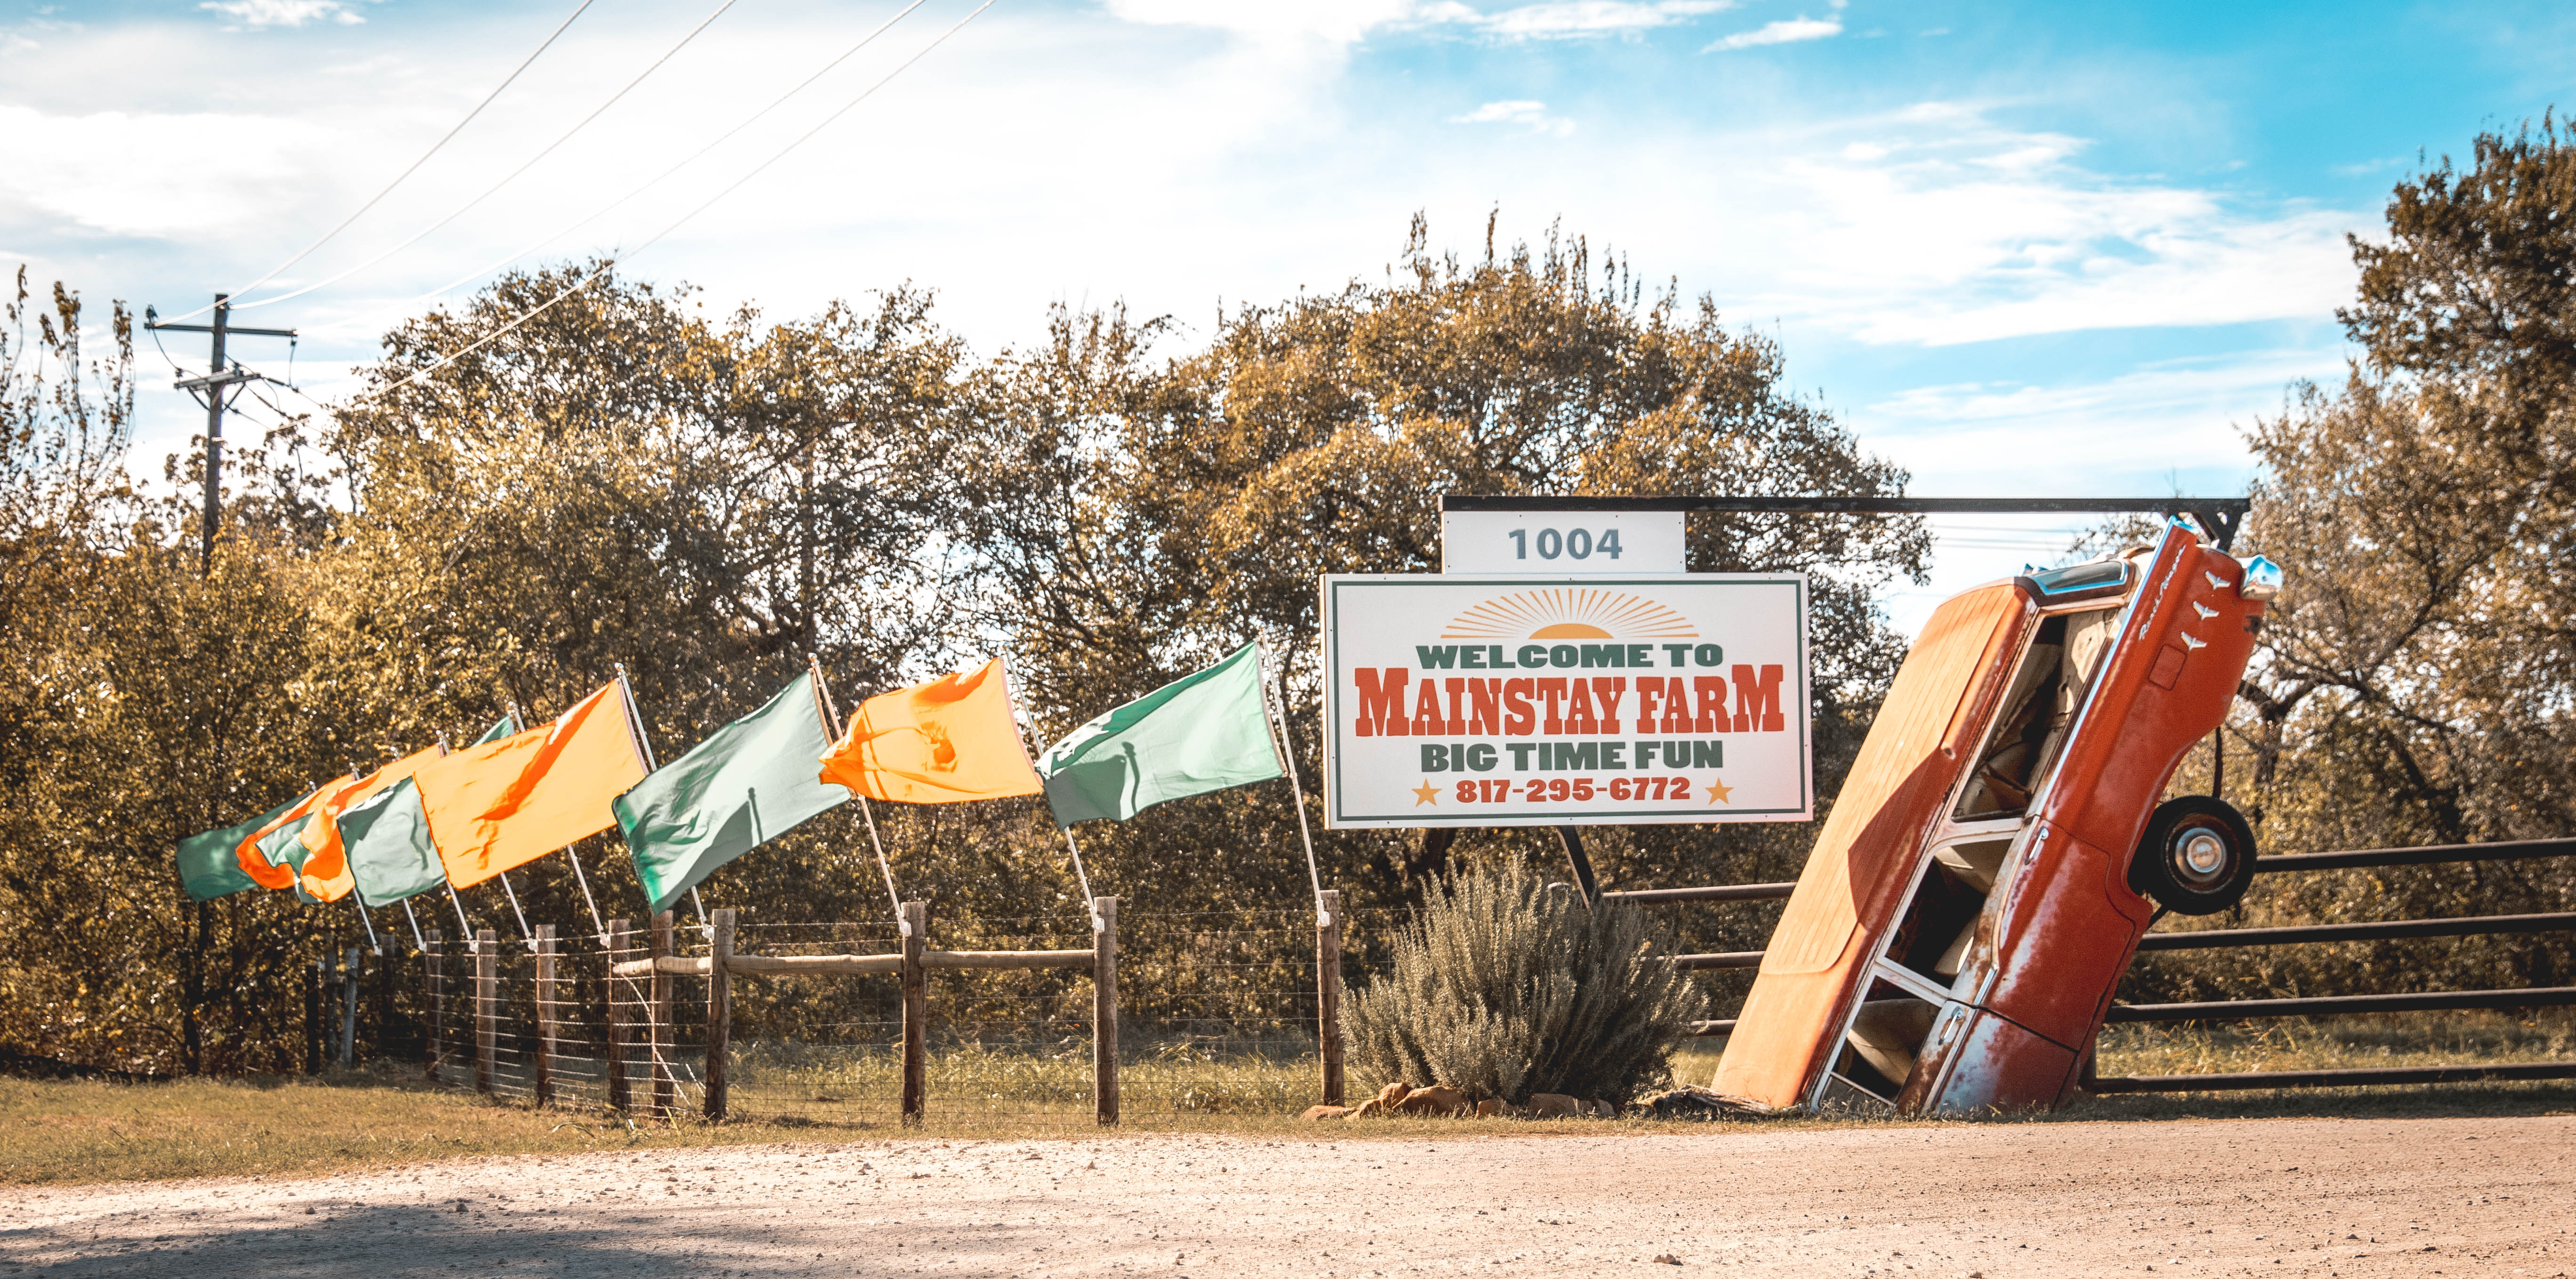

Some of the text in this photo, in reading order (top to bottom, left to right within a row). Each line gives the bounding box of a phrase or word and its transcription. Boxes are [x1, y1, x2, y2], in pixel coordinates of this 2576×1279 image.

[1508, 528, 1623, 560] 1004
[1415, 643, 1723, 669] WELCOME TO
[1354, 664, 1785, 737] MAINSTAY FARM
[1420, 740, 1723, 772] BIG TIME FUN
[1456, 776, 1690, 803] 817-295-6772
